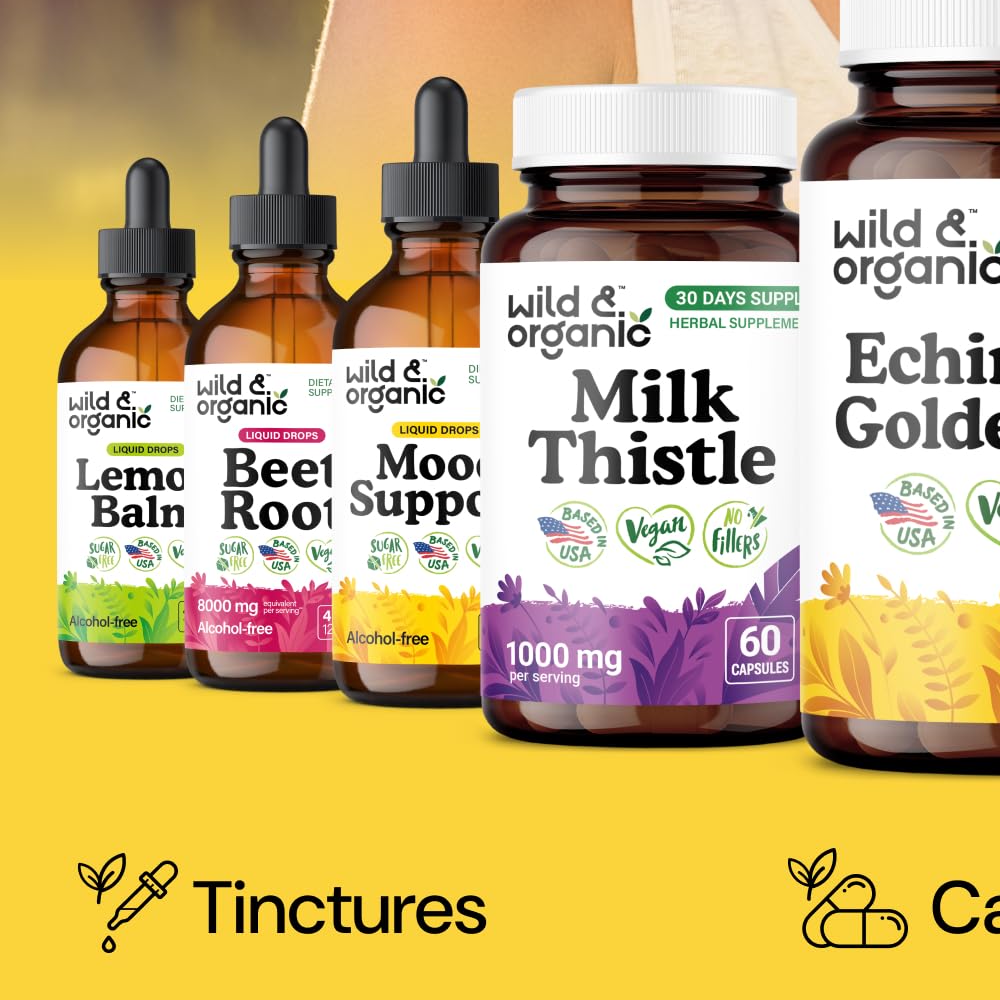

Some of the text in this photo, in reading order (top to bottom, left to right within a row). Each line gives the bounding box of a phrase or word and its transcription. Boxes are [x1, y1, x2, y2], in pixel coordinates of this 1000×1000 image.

[834, 208, 929, 249] wild
[508, 285, 580, 319] wild
[676, 291, 698, 305] 30
[703, 291, 746, 306] DAYS
[669, 317, 726, 329] HERBAL
[507, 312, 651, 360] organic
[346, 359, 395, 383] wild
[197, 374, 242, 396] wild
[69, 391, 109, 411] wild
[346, 378, 446, 413] organic
[571, 368, 740, 424] Milk
[197, 391, 288, 423] organic
[69, 407, 151, 436] organic
[399, 425, 479, 435] LIQUID DROPS
[246, 432, 319, 440] LIQUID DROPS
[113, 446, 179, 454] LIQUID DROPS
[528, 429, 776, 486] Thistle
[900, 480, 955, 530] BASED IN
[723, 507, 742, 527] NO
[562, 507, 607, 548] BASED IN
[626, 516, 687, 547] Vegan
[371, 537, 402, 553] SUGAR
[429, 536, 456, 553] BASED
[897, 527, 936, 548] USA
[89, 541, 116, 554] SUGAR
[137, 539, 160, 554] BASED
[219, 541, 248, 556] SUGAR
[272, 539, 297, 555] BASED
[560, 545, 592, 563] USA
[99, 554, 115, 568] FREE
[136, 559, 154, 568] USA
[230, 556, 247, 571] FREE
[272, 561, 291, 571] USA
[381, 553, 401, 570] FREE
[428, 559, 449, 570] USA
[197, 599, 259, 617] 8000 mg
[263, 599, 297, 608] equivalent
[69, 615, 138, 628] Alcohol-free
[197, 621, 273, 635] Alcohol-free
[346, 631, 429, 646] Alcohol-free
[740, 624, 781, 657] 60
[506, 641, 623, 676] 1000 mg
[731, 661, 790, 677] CAPSULES
[510, 671, 581, 687] per serving
